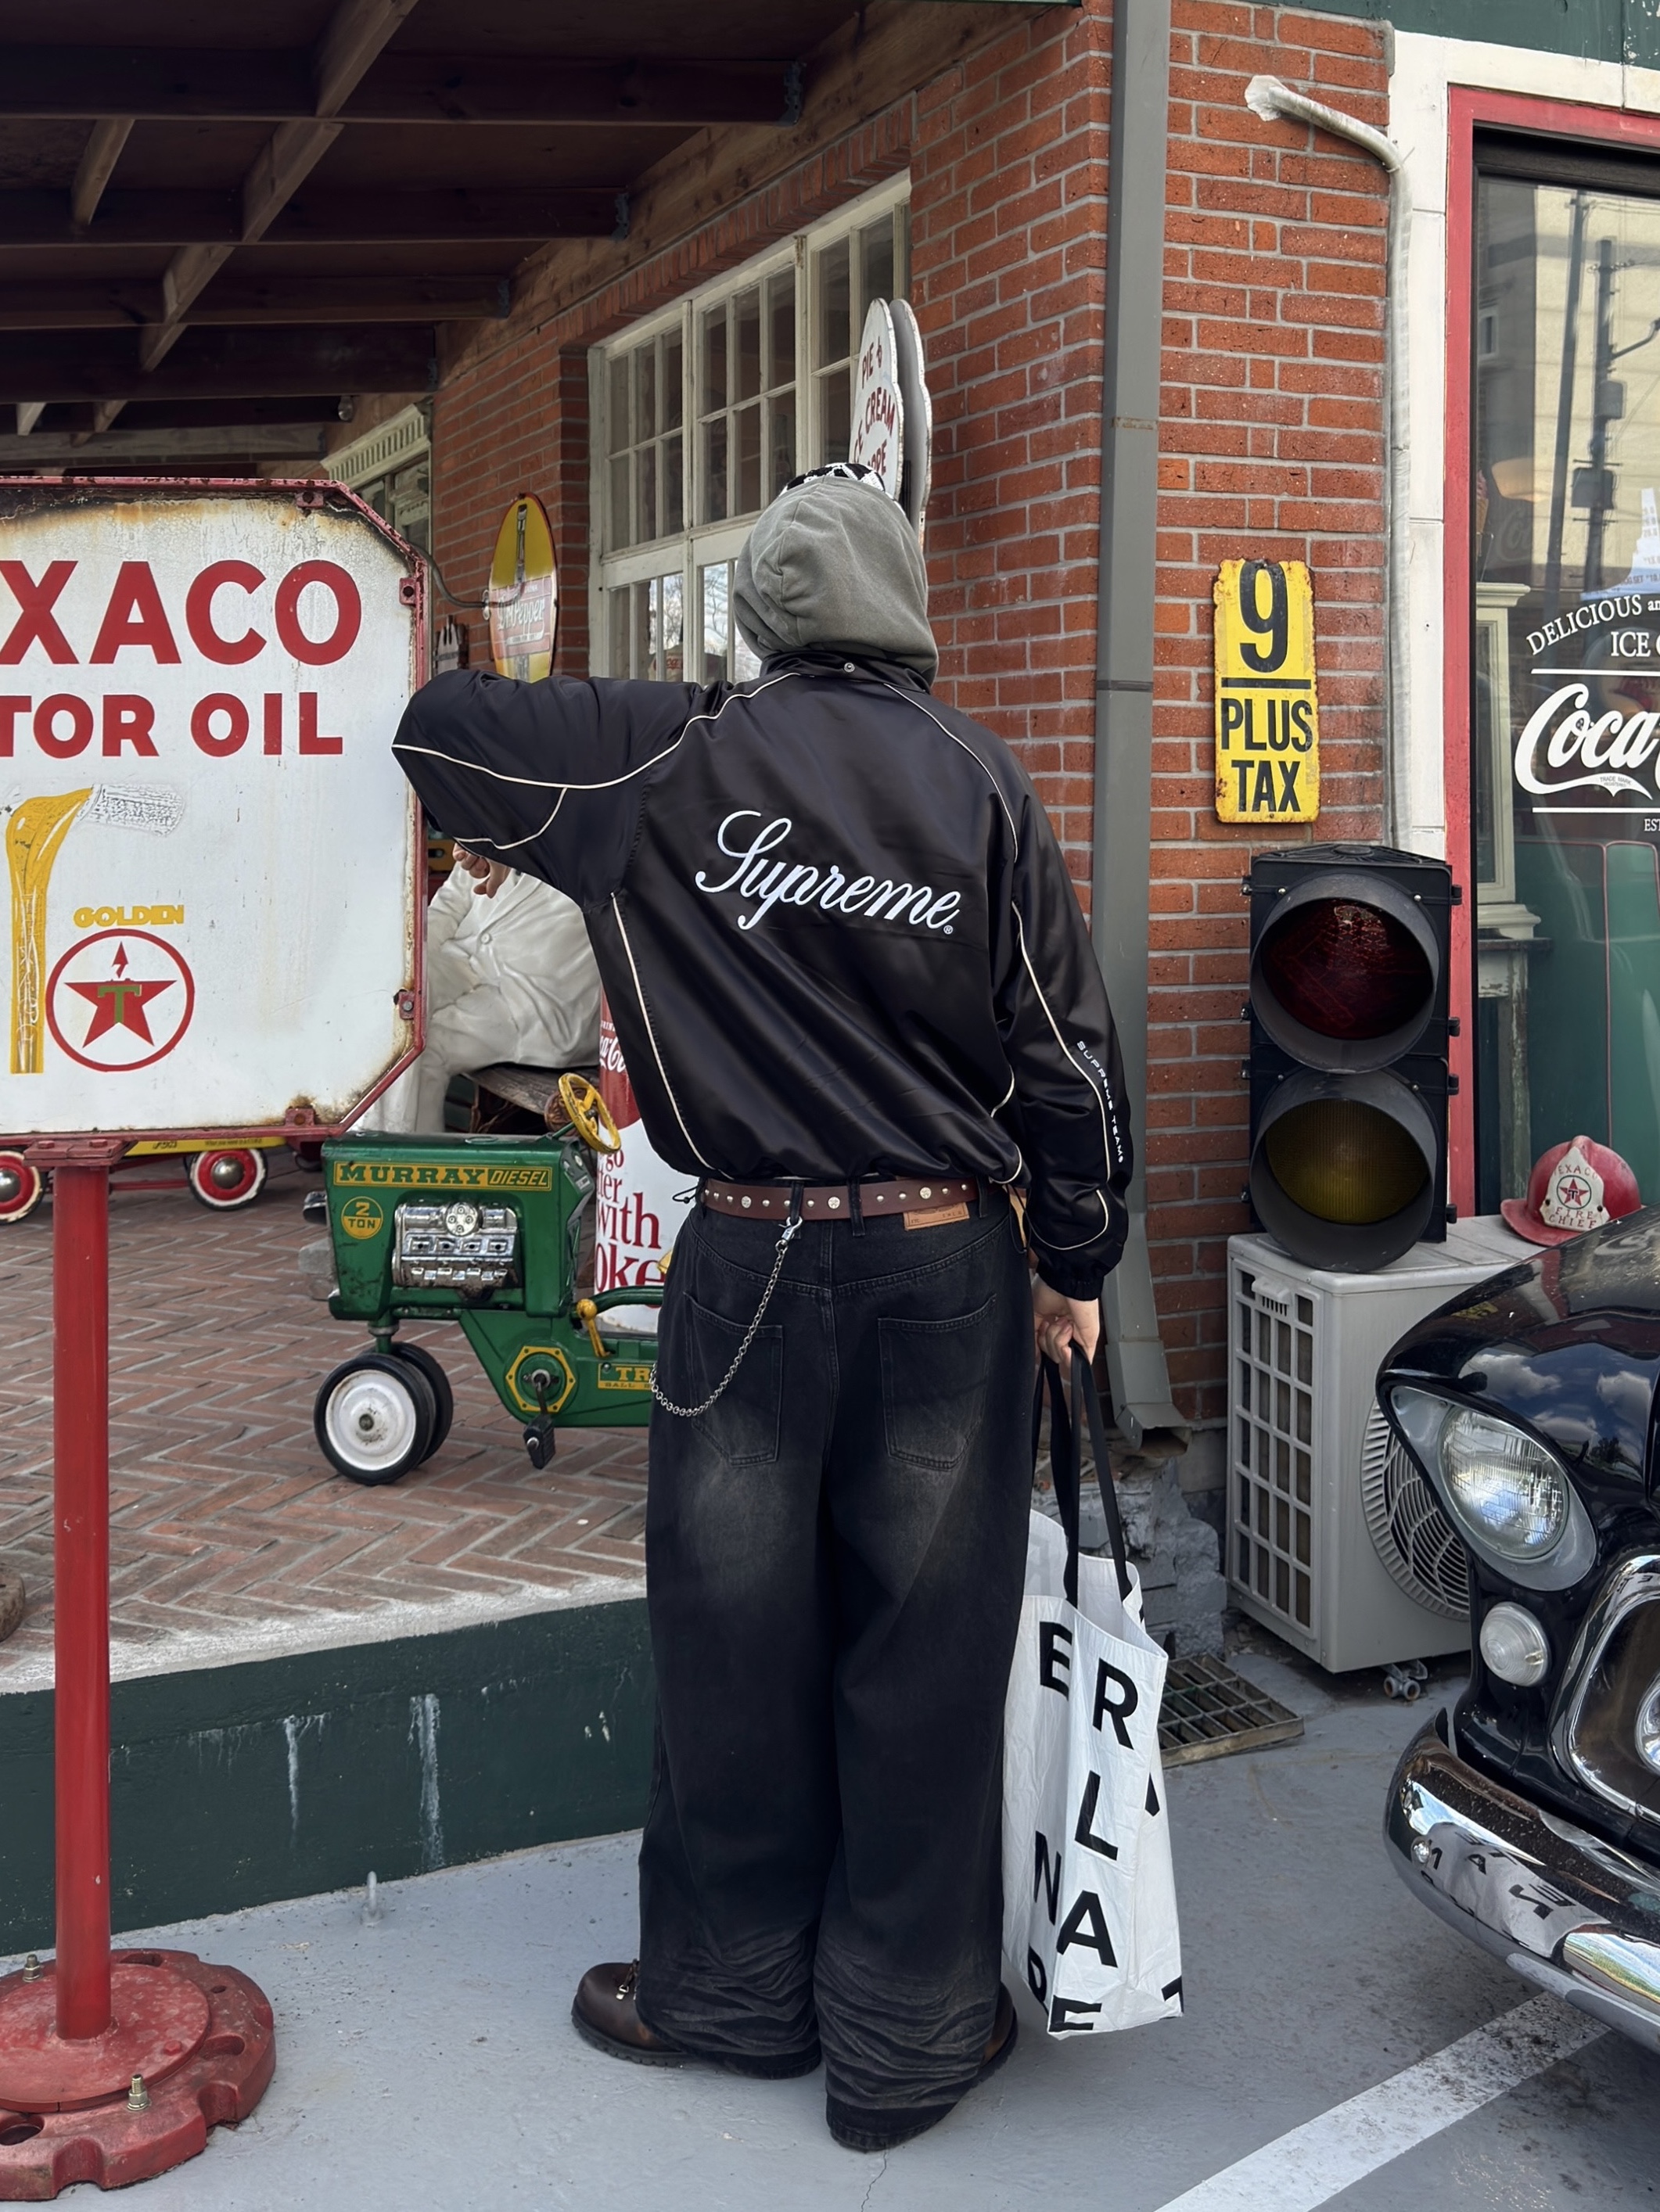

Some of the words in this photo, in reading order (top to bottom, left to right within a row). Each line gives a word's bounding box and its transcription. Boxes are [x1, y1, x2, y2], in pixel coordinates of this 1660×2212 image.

[862, 342, 875, 389] PIE
[865, 386, 896, 437] CREAM
[1239, 560, 1288, 673] 9
[1525, 594, 1642, 655] DELICIOUS
[1611, 631, 1651, 657] ICE
[190, 691, 344, 757] OIL
[1221, 698, 1315, 753] PLUS
[1231, 759, 1301, 813] TAX
[74, 904, 185, 928] GOLDEN
[1076, 1040, 1113, 1111] SUPREME
[1111, 1115, 1124, 1157] TEAM
[340, 1165, 486, 1185] MURRAY
[488, 1169, 548, 1187] DIESEL
[355, 1201, 371, 1216] 2
[1555, 1206, 1594, 1219] FIRE
[1568, 1189, 1579, 1200] T
[347, 1218, 375, 1230] TON
[1549, 1214, 1597, 1229] CHIEF
